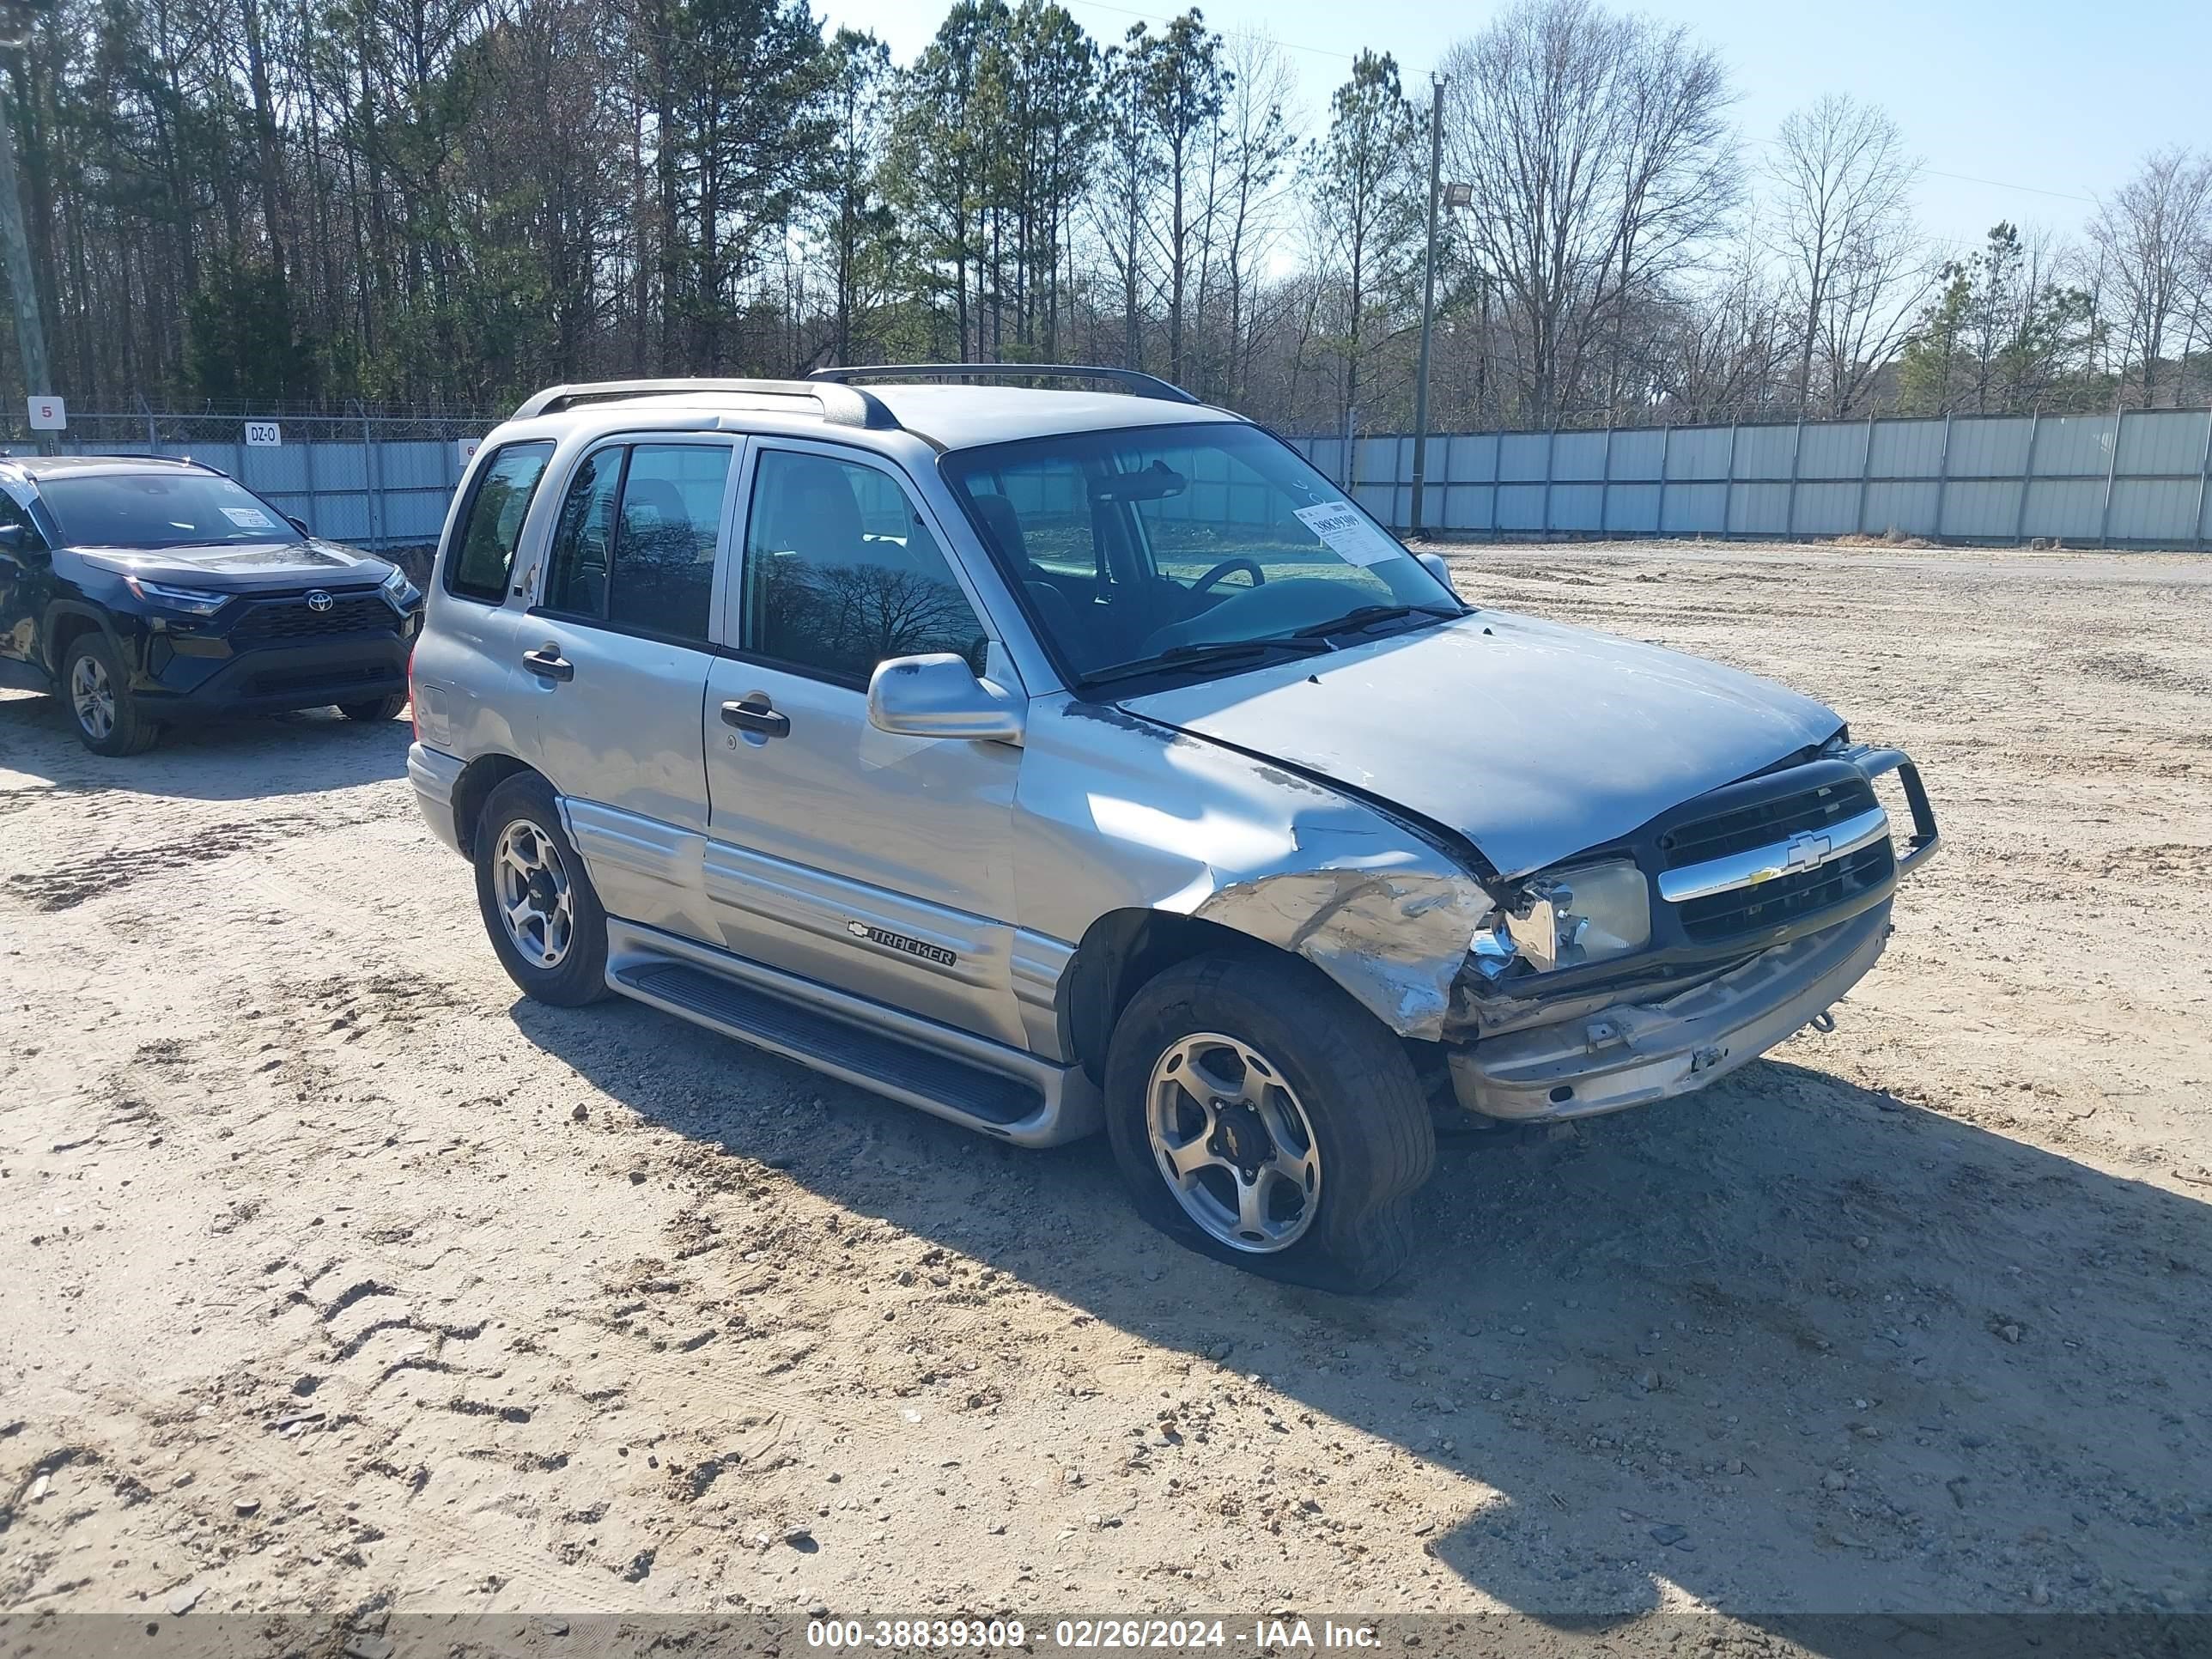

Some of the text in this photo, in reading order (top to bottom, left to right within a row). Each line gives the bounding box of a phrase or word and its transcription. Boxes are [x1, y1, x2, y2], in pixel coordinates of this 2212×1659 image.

[41, 406, 52, 418] 5
[467, 447, 475, 456] 6
[1313, 514, 1360, 533] 38839309
[872, 928, 953, 964] TRACKER
